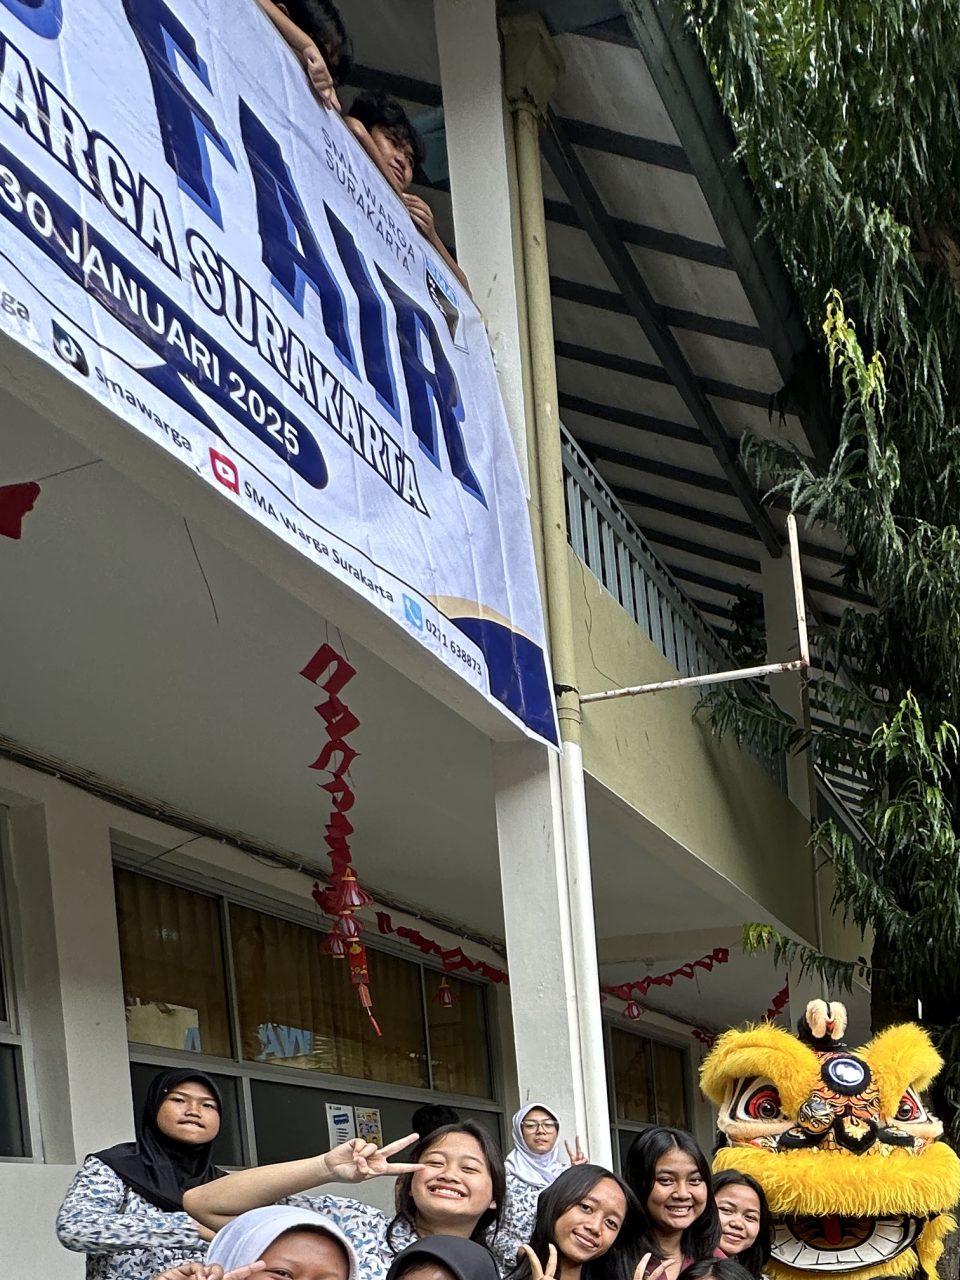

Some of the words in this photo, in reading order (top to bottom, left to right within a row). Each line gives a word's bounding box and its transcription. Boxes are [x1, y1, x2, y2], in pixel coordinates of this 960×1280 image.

[0, 30, 182, 280] ARGA
[186, 228, 431, 519] SURAKARTA
[121, 0, 489, 512] FAIR
[321, 126, 359, 182] SMA
[361, 179, 415, 265] WARGA
[324, 148, 411, 276] SURAKARTA
[66, 227, 221, 388] JANUARI
[228, 370, 300, 457] 2025
[94, 365, 193, 453] smawarga
[244, 480, 279, 521] SMA
[279, 511, 329, 558] Warga
[332, 547, 394, 603] Surakarta
[425, 617, 448, 648] 0271
[449, 640, 482, 676] 638873
